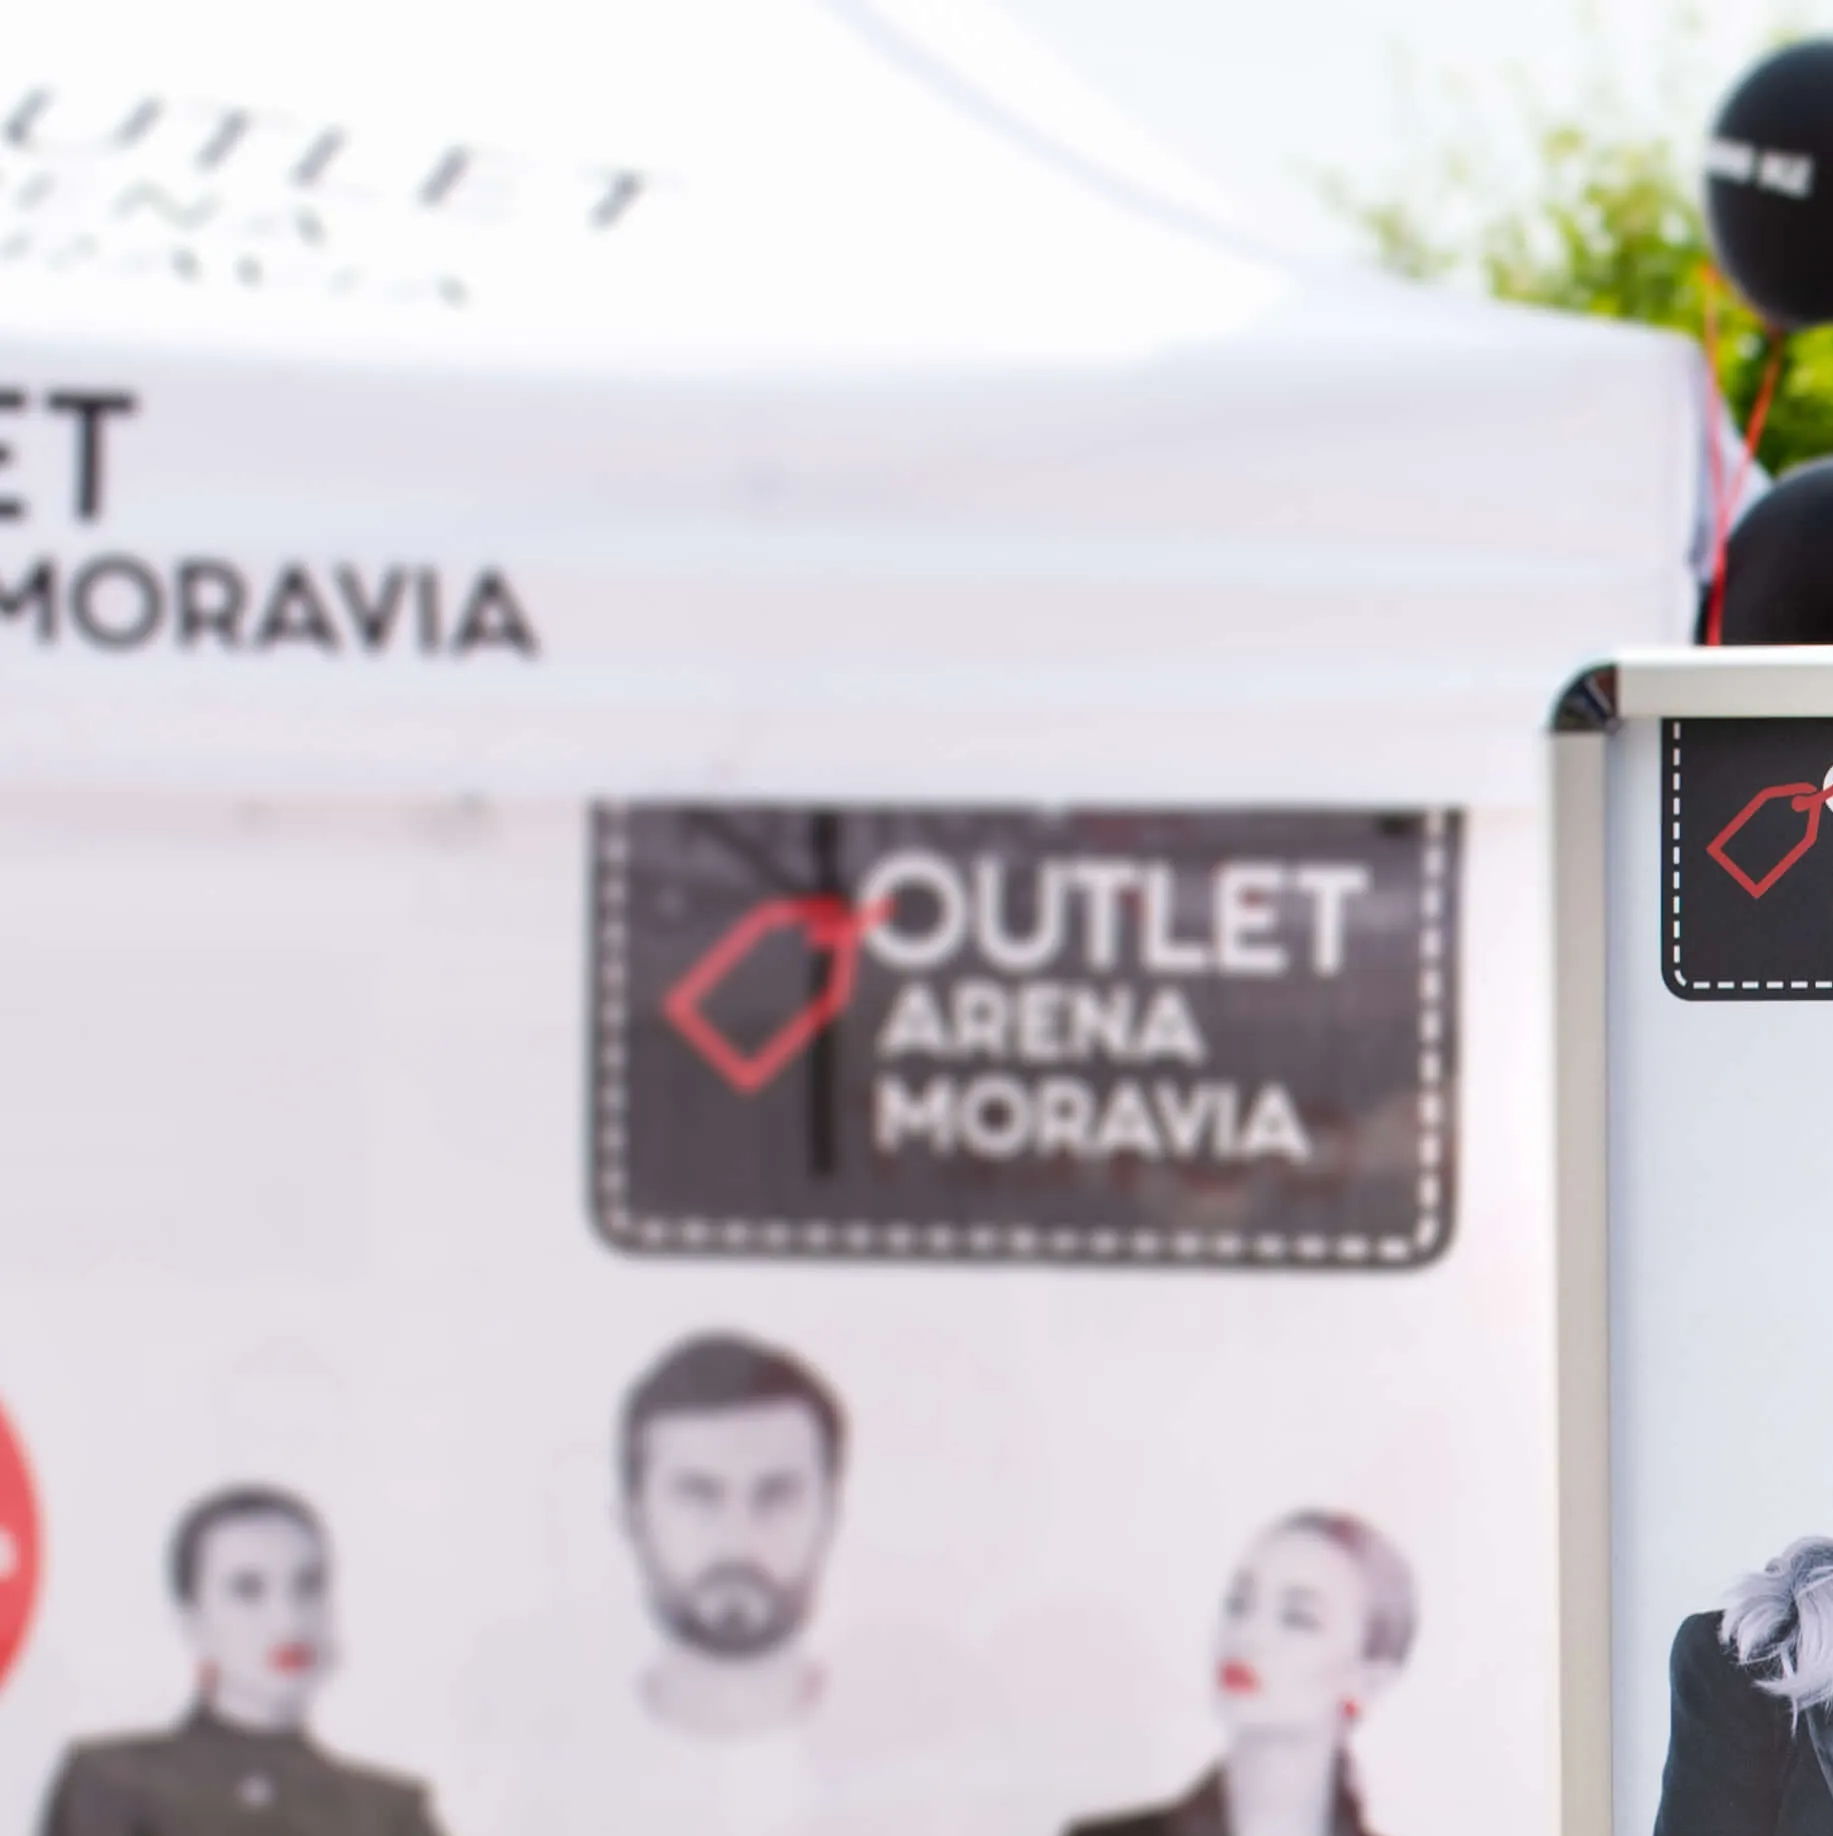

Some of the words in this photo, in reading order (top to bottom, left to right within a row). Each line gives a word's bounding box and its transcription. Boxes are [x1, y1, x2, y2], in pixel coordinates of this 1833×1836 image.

[858, 850, 1370, 976] OUTLET
[878, 982, 1206, 1065] ARENA
[873, 1073, 1309, 1160] MORAVIA
